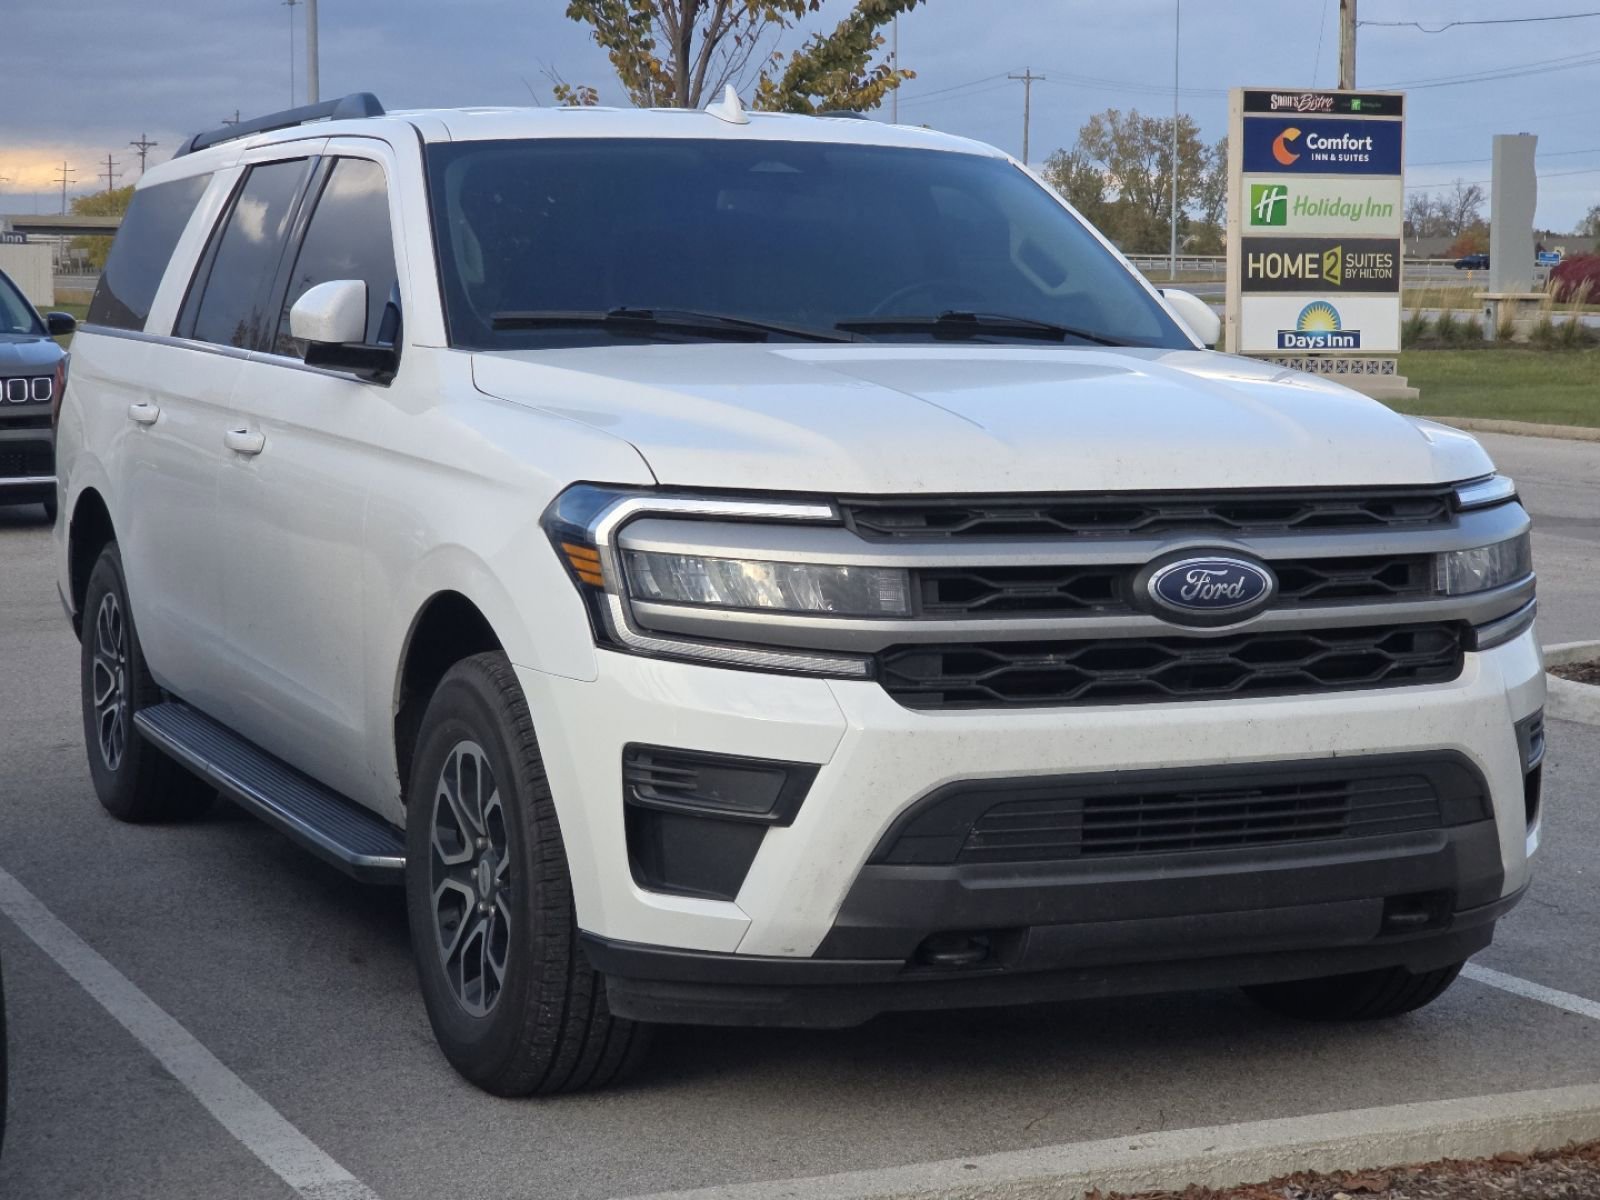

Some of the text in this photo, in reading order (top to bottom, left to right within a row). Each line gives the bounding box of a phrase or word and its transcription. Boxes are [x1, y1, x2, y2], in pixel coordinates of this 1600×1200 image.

[1306, 133, 1373, 151] Comfort
[1311, 153, 1328, 161] INN
[1338, 154, 1370, 162] SUITES
[1293, 195, 1394, 222] Holiday Inn
[1248, 251, 1393, 281] HOME 2 SUITES
[1345, 268, 1392, 279] BY HILTON
[1284, 333, 1354, 349] Days Inn
[1180, 568, 1245, 601] Ford
